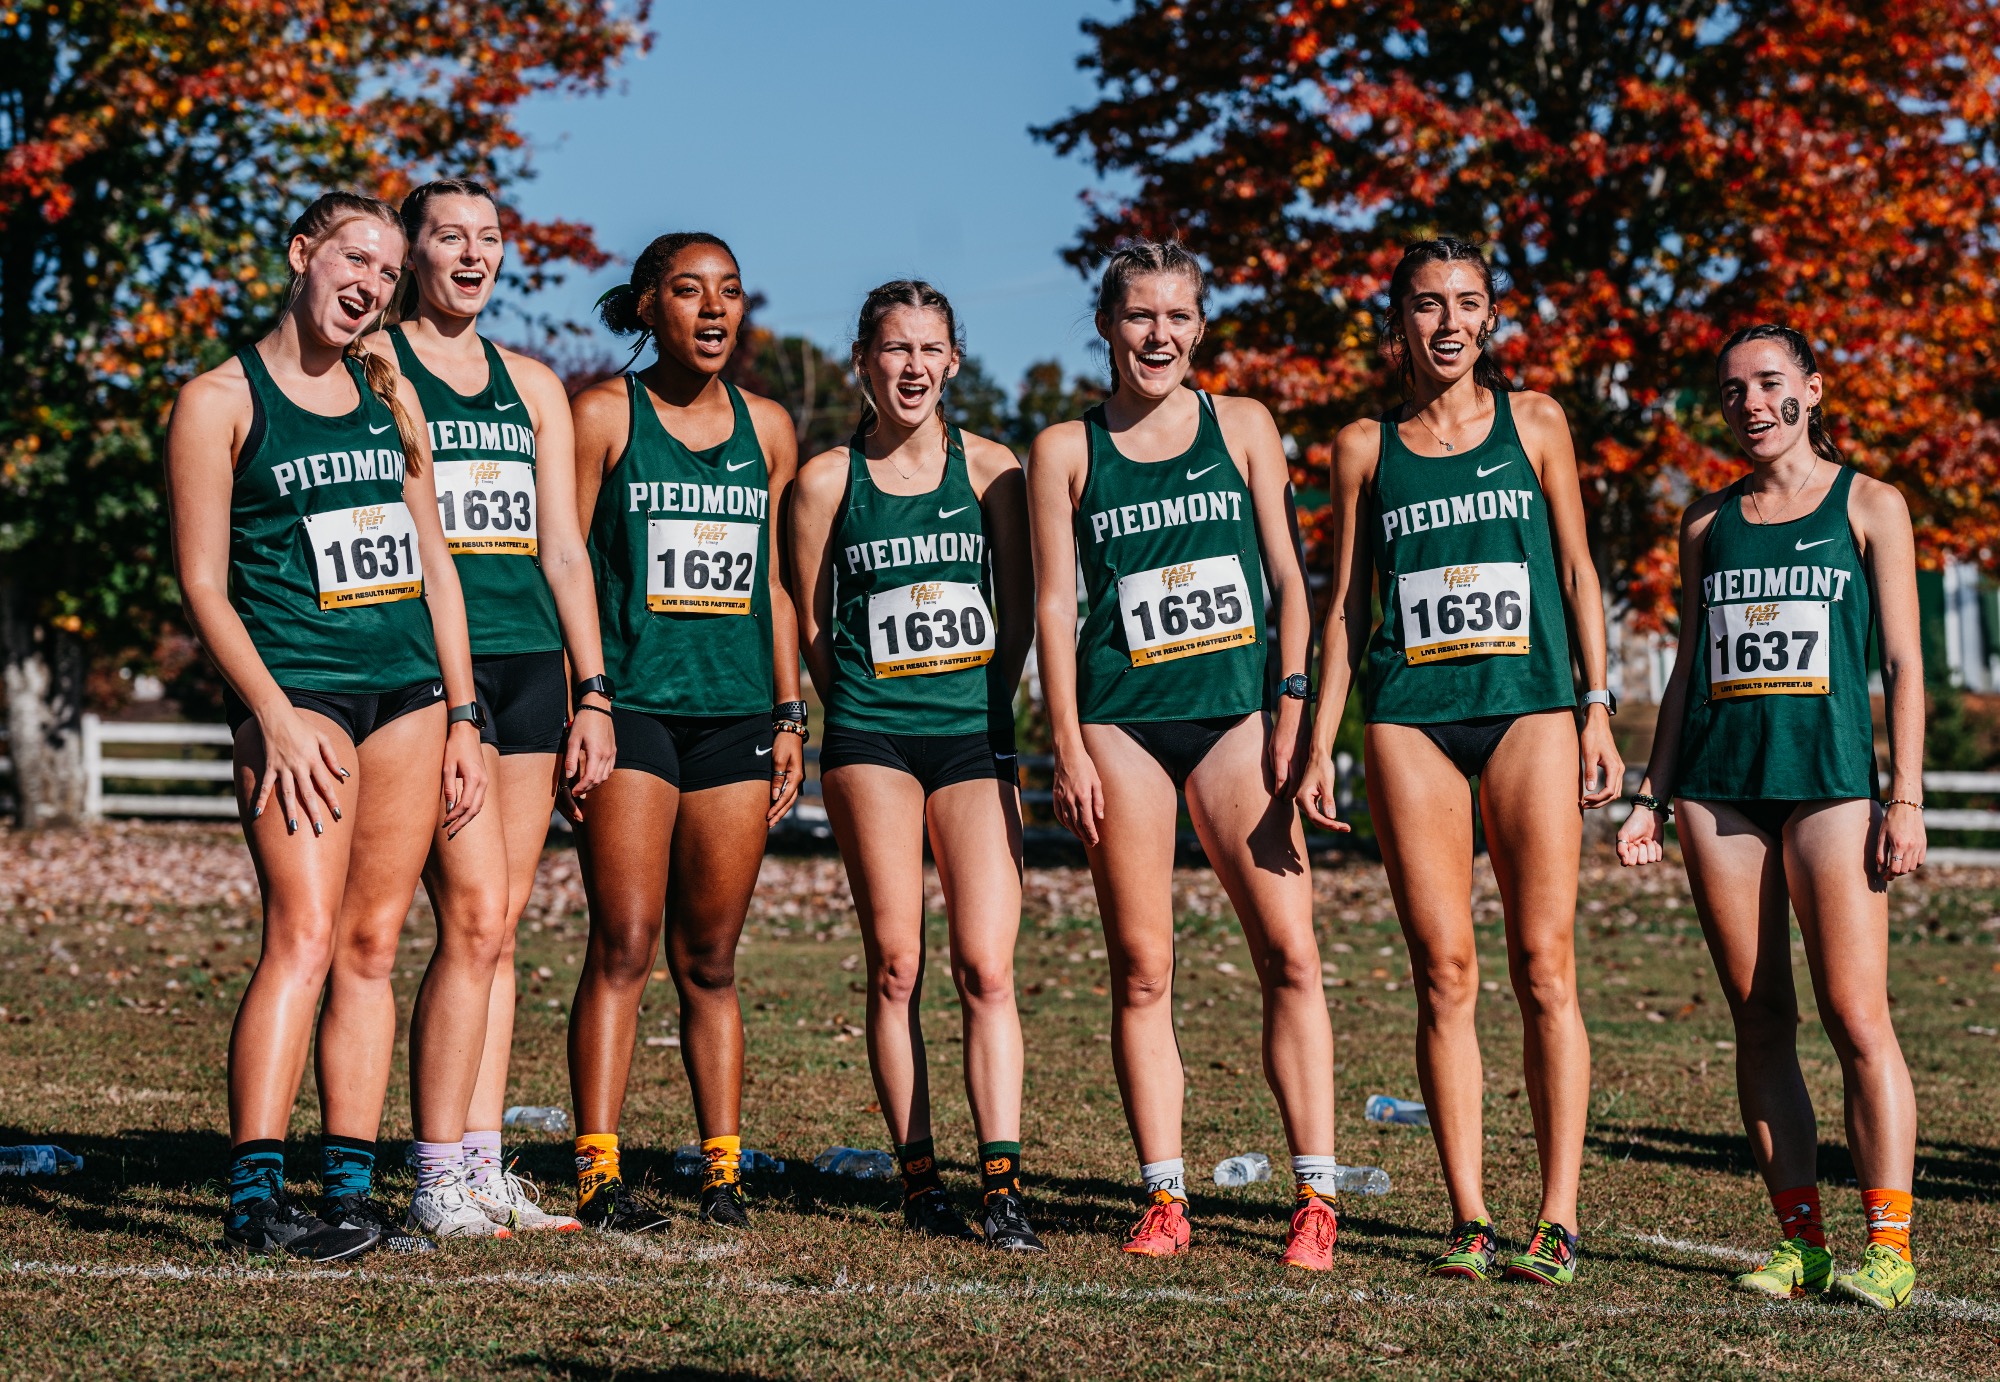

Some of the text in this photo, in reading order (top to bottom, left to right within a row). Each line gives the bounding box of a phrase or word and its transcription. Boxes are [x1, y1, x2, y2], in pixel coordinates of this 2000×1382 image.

[470, 462, 500, 473] FAST
[474, 471, 502, 484] FEET
[628, 482, 768, 519] PIEDMONT
[352, 507, 384, 524] FAST
[437, 490, 532, 532] 1633
[1090, 491, 1242, 544] PIEDMONT
[1382, 489, 1532, 543] PIEDMONT
[359, 515, 386, 531] FEET
[693, 523, 728, 536] FAST
[448, 541, 460, 549] IVE
[494, 541, 529, 549] FASTFEET.US
[698, 532, 728, 543] FEET
[324, 532, 414, 583] 1631
[845, 533, 985, 575] PIEDMONT
[657, 548, 753, 592] 1632
[1161, 563, 1194, 584] FAST
[1443, 565, 1479, 582] FAST
[1167, 571, 1197, 590] FEET
[1449, 573, 1480, 589] FEET
[1703, 565, 1851, 603] PIEDMONT
[355, 590, 385, 600] RESULTS
[385, 587, 415, 596] FASTFEET.US
[910, 583, 942, 598] FAST
[915, 591, 945, 606] FEET
[710, 601, 746, 609] FASTFEET.US
[1131, 584, 1243, 642] 1635
[1744, 604, 1780, 620] FAST
[1410, 590, 1522, 640] 1636
[1749, 612, 1780, 628] FEET
[878, 607, 986, 655] 1630
[1146, 633, 1243, 659] LIVE RESULTS FASTFEET.US
[1437, 644, 1469, 654] RESULTS
[1470, 641, 1517, 650] FASTFEET.US
[1715, 630, 1819, 675] 1637
[889, 655, 982, 672] LIVE RESULTS FASTFEET.US
[1733, 682, 1763, 690] RESULTS
[1763, 681, 1813, 689] FASTFEET.US
